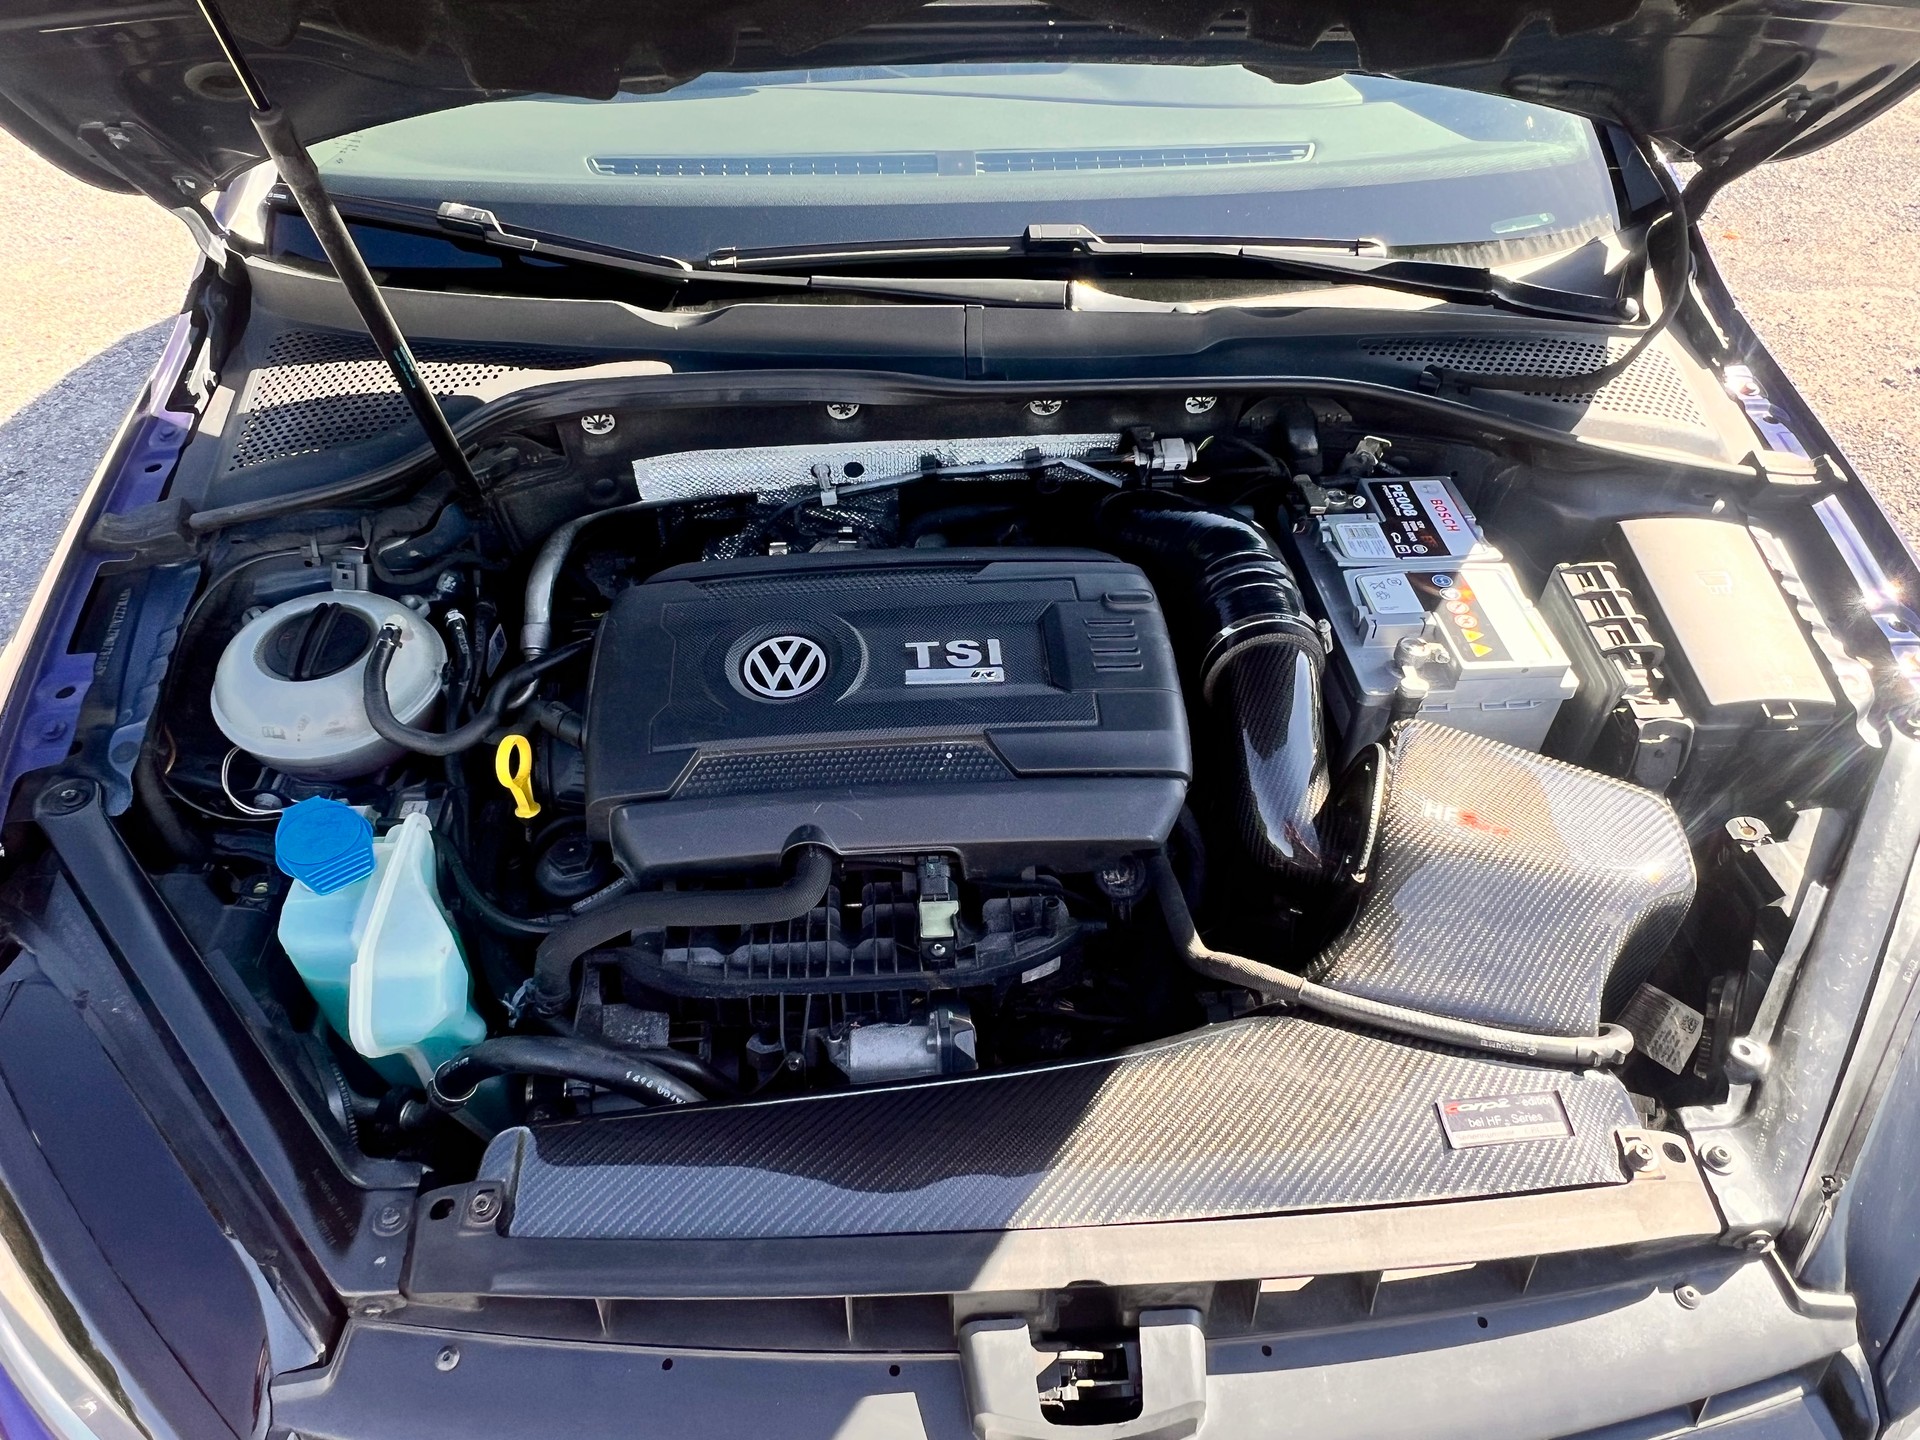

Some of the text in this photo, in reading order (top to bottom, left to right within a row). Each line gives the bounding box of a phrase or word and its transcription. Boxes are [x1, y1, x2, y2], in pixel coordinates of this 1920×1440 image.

[1388, 484, 1418, 517] PE008
[1430, 499, 1461, 532] BOSCH
[905, 638, 1003, 669] TSI
[1485, 1114, 1502, 1126] HF
[1510, 1112, 1544, 1124] Series
